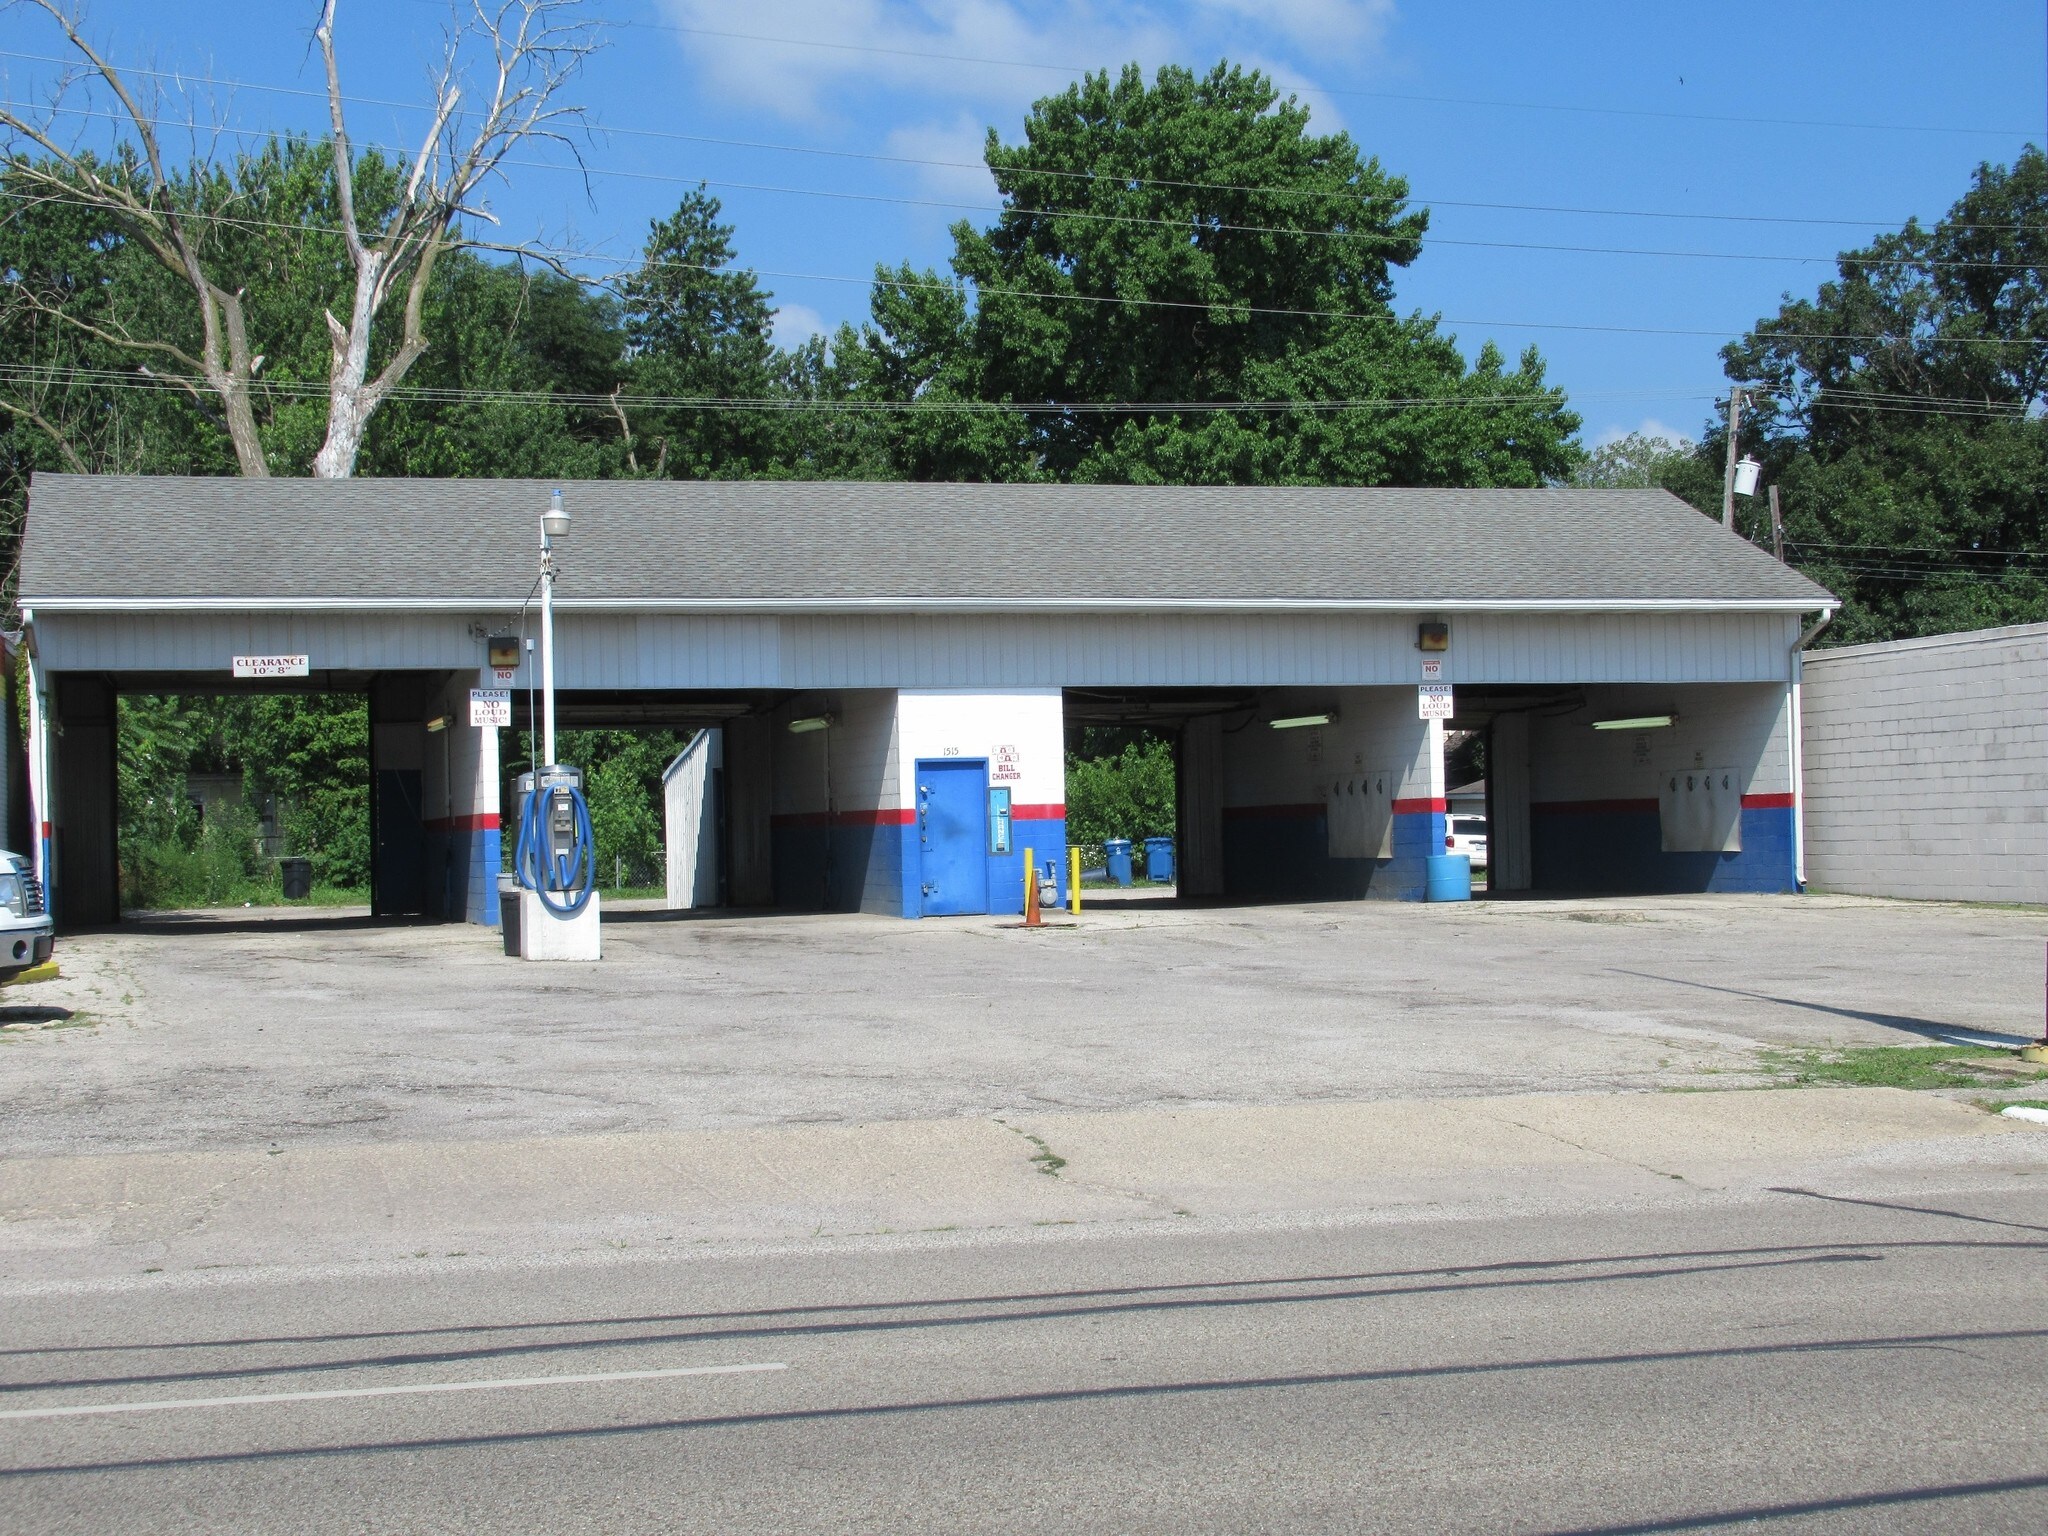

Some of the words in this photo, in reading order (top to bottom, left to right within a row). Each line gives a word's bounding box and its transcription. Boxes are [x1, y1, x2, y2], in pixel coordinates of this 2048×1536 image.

[237, 658, 305, 666] CLEARANCE
[497, 671, 512, 679] NO
[483, 700, 500, 708] NO
[943, 747, 959, 756] 1515
[992, 773, 1021, 781] CHANGER
